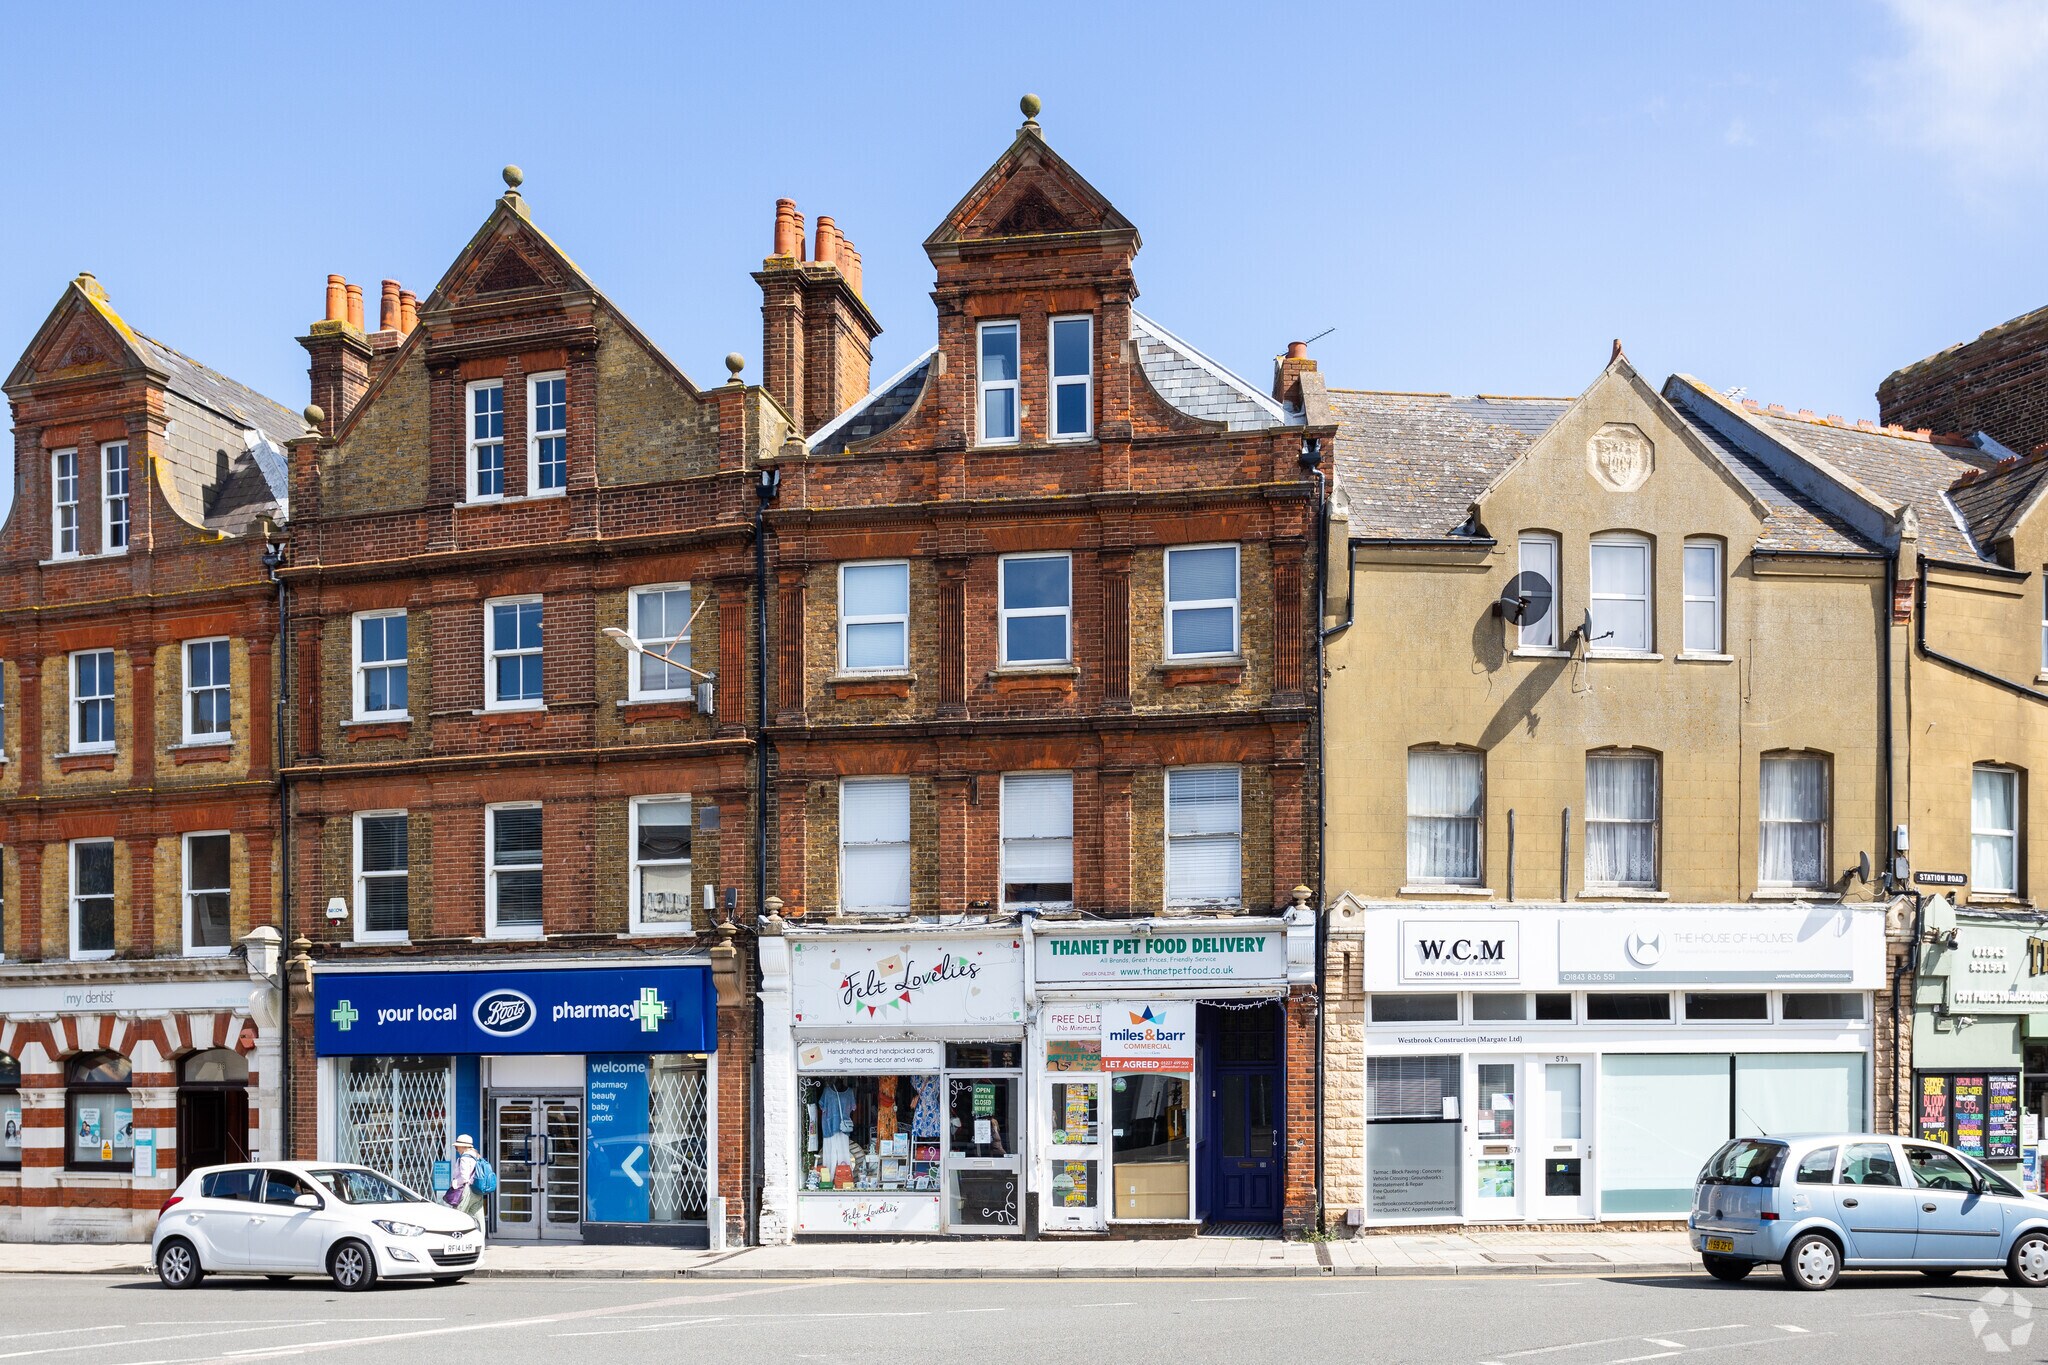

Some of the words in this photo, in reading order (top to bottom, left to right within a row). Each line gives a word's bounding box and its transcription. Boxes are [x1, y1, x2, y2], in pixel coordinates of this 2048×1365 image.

[1919, 874, 1946, 882] STATION
[1947, 875, 1964, 883] ROAD
[1674, 932, 1692, 944] THE
[1695, 932, 1730, 944] HOUSE
[1732, 932, 1748, 944] OF
[1750, 932, 1793, 944] HOLMES
[1050, 940, 1109, 956] THANET
[1114, 939, 1140, 954] PET
[1146, 938, 1187, 954] FOOD
[1192, 936, 1266, 954] DELIVERY
[1418, 939, 1506, 960] W.C.M
[1120, 966, 1234, 977] www.thanetpetfood.co.uk
[843, 971, 888, 1005] Felt
[894, 954, 981, 990] Lovelies
[86, 990, 114, 1004] dentist
[378, 1004, 414, 1026] your
[417, 1004, 457, 1022] local
[484, 1000, 525, 1026] Boots
[552, 1001, 639, 1022] pharmacy
[1052, 1014, 1075, 1024] FREE
[1478, 1036, 1507, 1044] (Margate
[879, 1048, 916, 1056] handpicked
[916, 1047, 935, 1056] cards,
[838, 1056, 853, 1064] gifts,
[1122, 1060, 1159, 1068] AGREED
[592, 1061, 646, 1073] welcome
[592, 1081, 628, 1090] pharmacy
[592, 1092, 616, 1100] beauty
[1924, 1095, 1946, 1106] BLOODY
[592, 1103, 609, 1112] baby
[1925, 1106, 1944, 1117] MARY
[592, 1114, 613, 1122] photo
[1924, 1130, 1930, 1141] 3
[1938, 1129, 1948, 1145] £10
[2004, 1147, 2014, 1155] £5
[843, 1208, 860, 1222] Felt
[864, 1202, 898, 1218] Lovelies
